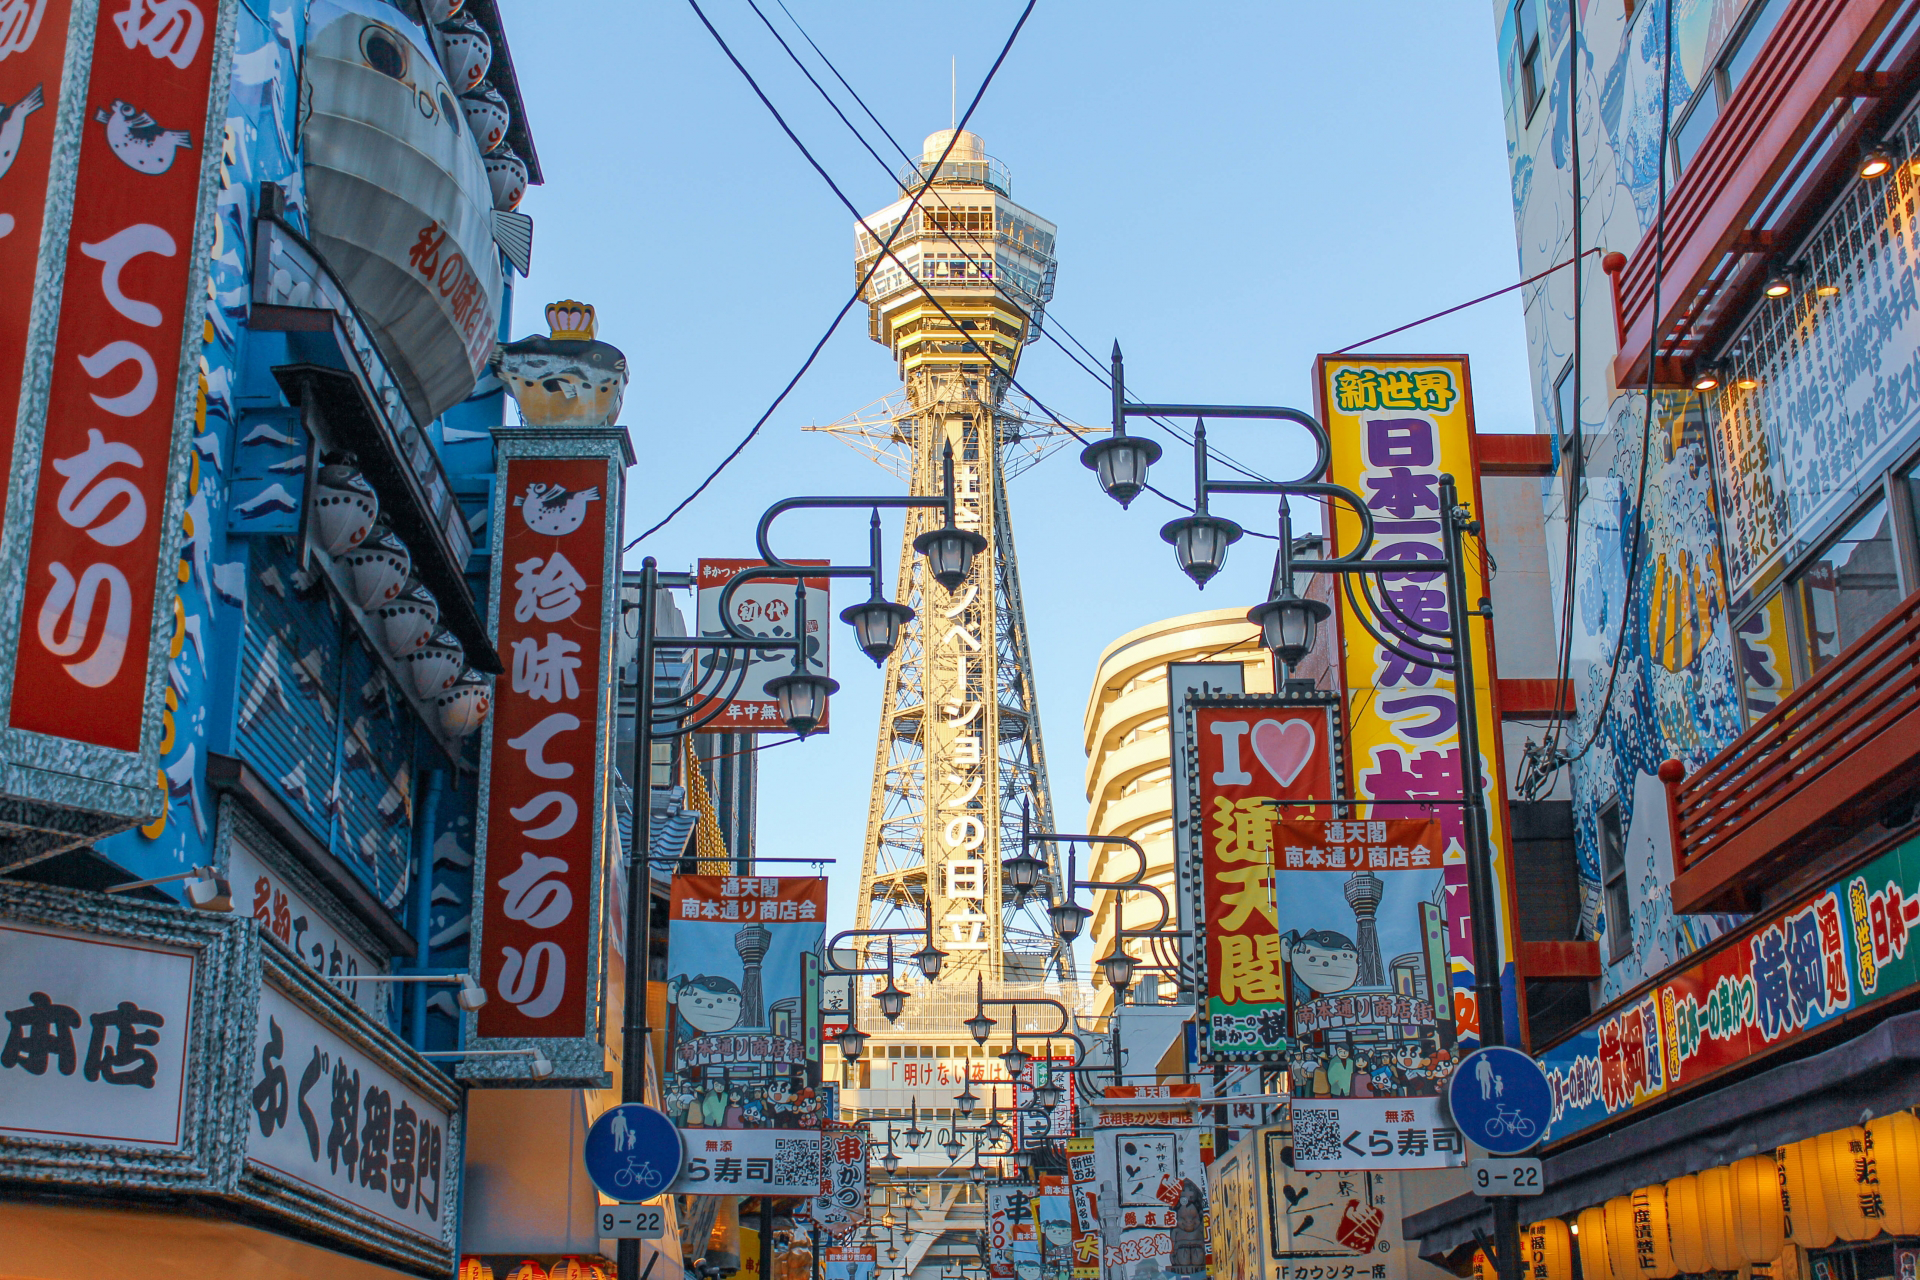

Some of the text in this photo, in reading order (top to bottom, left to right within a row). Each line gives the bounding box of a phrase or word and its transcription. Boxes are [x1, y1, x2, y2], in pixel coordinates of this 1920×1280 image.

[1337, 368, 1454, 410] 新世界
[1806, 372, 1832, 497] 白ねぎ
[1816, 360, 1843, 486] さつま芋
[38, 223, 177, 688] てっちり
[1784, 396, 1810, 518] れんこん
[1746, 442, 1771, 558] にんにく
[1755, 431, 1780, 548] 玉ねぎ
[1366, 416, 1459, 738] 日本一の串かつ
[737, 598, 790, 622] 初代
[497, 551, 588, 1018] 珍味てっちり
[1324, 820, 1388, 844] 通天閣
[1284, 845, 1432, 869] 南本通り商店会
[720, 877, 779, 898] 通天閣
[681, 898, 817, 921] 南本通り商店会
[1850, 877, 1877, 994] 新世界
[1677, 974, 1757, 1058] 日本一の串かつ
[1751, 910, 1826, 1040] 横綱
[1817, 897, 1852, 1010] 酒処
[1213, 1015, 1258, 1028] 日本一の
[1297, 999, 1434, 1024] 南本通り商店街
[0, 991, 165, 1090] 本店
[680, 1039, 806, 1061] 南本通り商店街
[1214, 1029, 1257, 1044] 串かつ
[1550, 1056, 1600, 1121] 本一の串かつ
[1598, 1010, 1648, 1112] 横綱
[1133, 1086, 1171, 1099] 通天閣
[251, 1014, 443, 1223] ふぐ料理専門
[1098, 1111, 1193, 1126] 元祖串カツ専門店
[1384, 1110, 1415, 1123] 無添
[705, 1140, 733, 1153] 無添
[1342, 1126, 1464, 1158] くら寿司
[687, 1157, 774, 1184] ら寿司
[833, 1133, 864, 1206] 串かつ
[1070, 1154, 1096, 1169] 新世
[1003, 1189, 1034, 1226] 串
[1074, 1185, 1090, 1231] 大阪名物
[1275, 1264, 1387, 1280] 1F カウンター席
